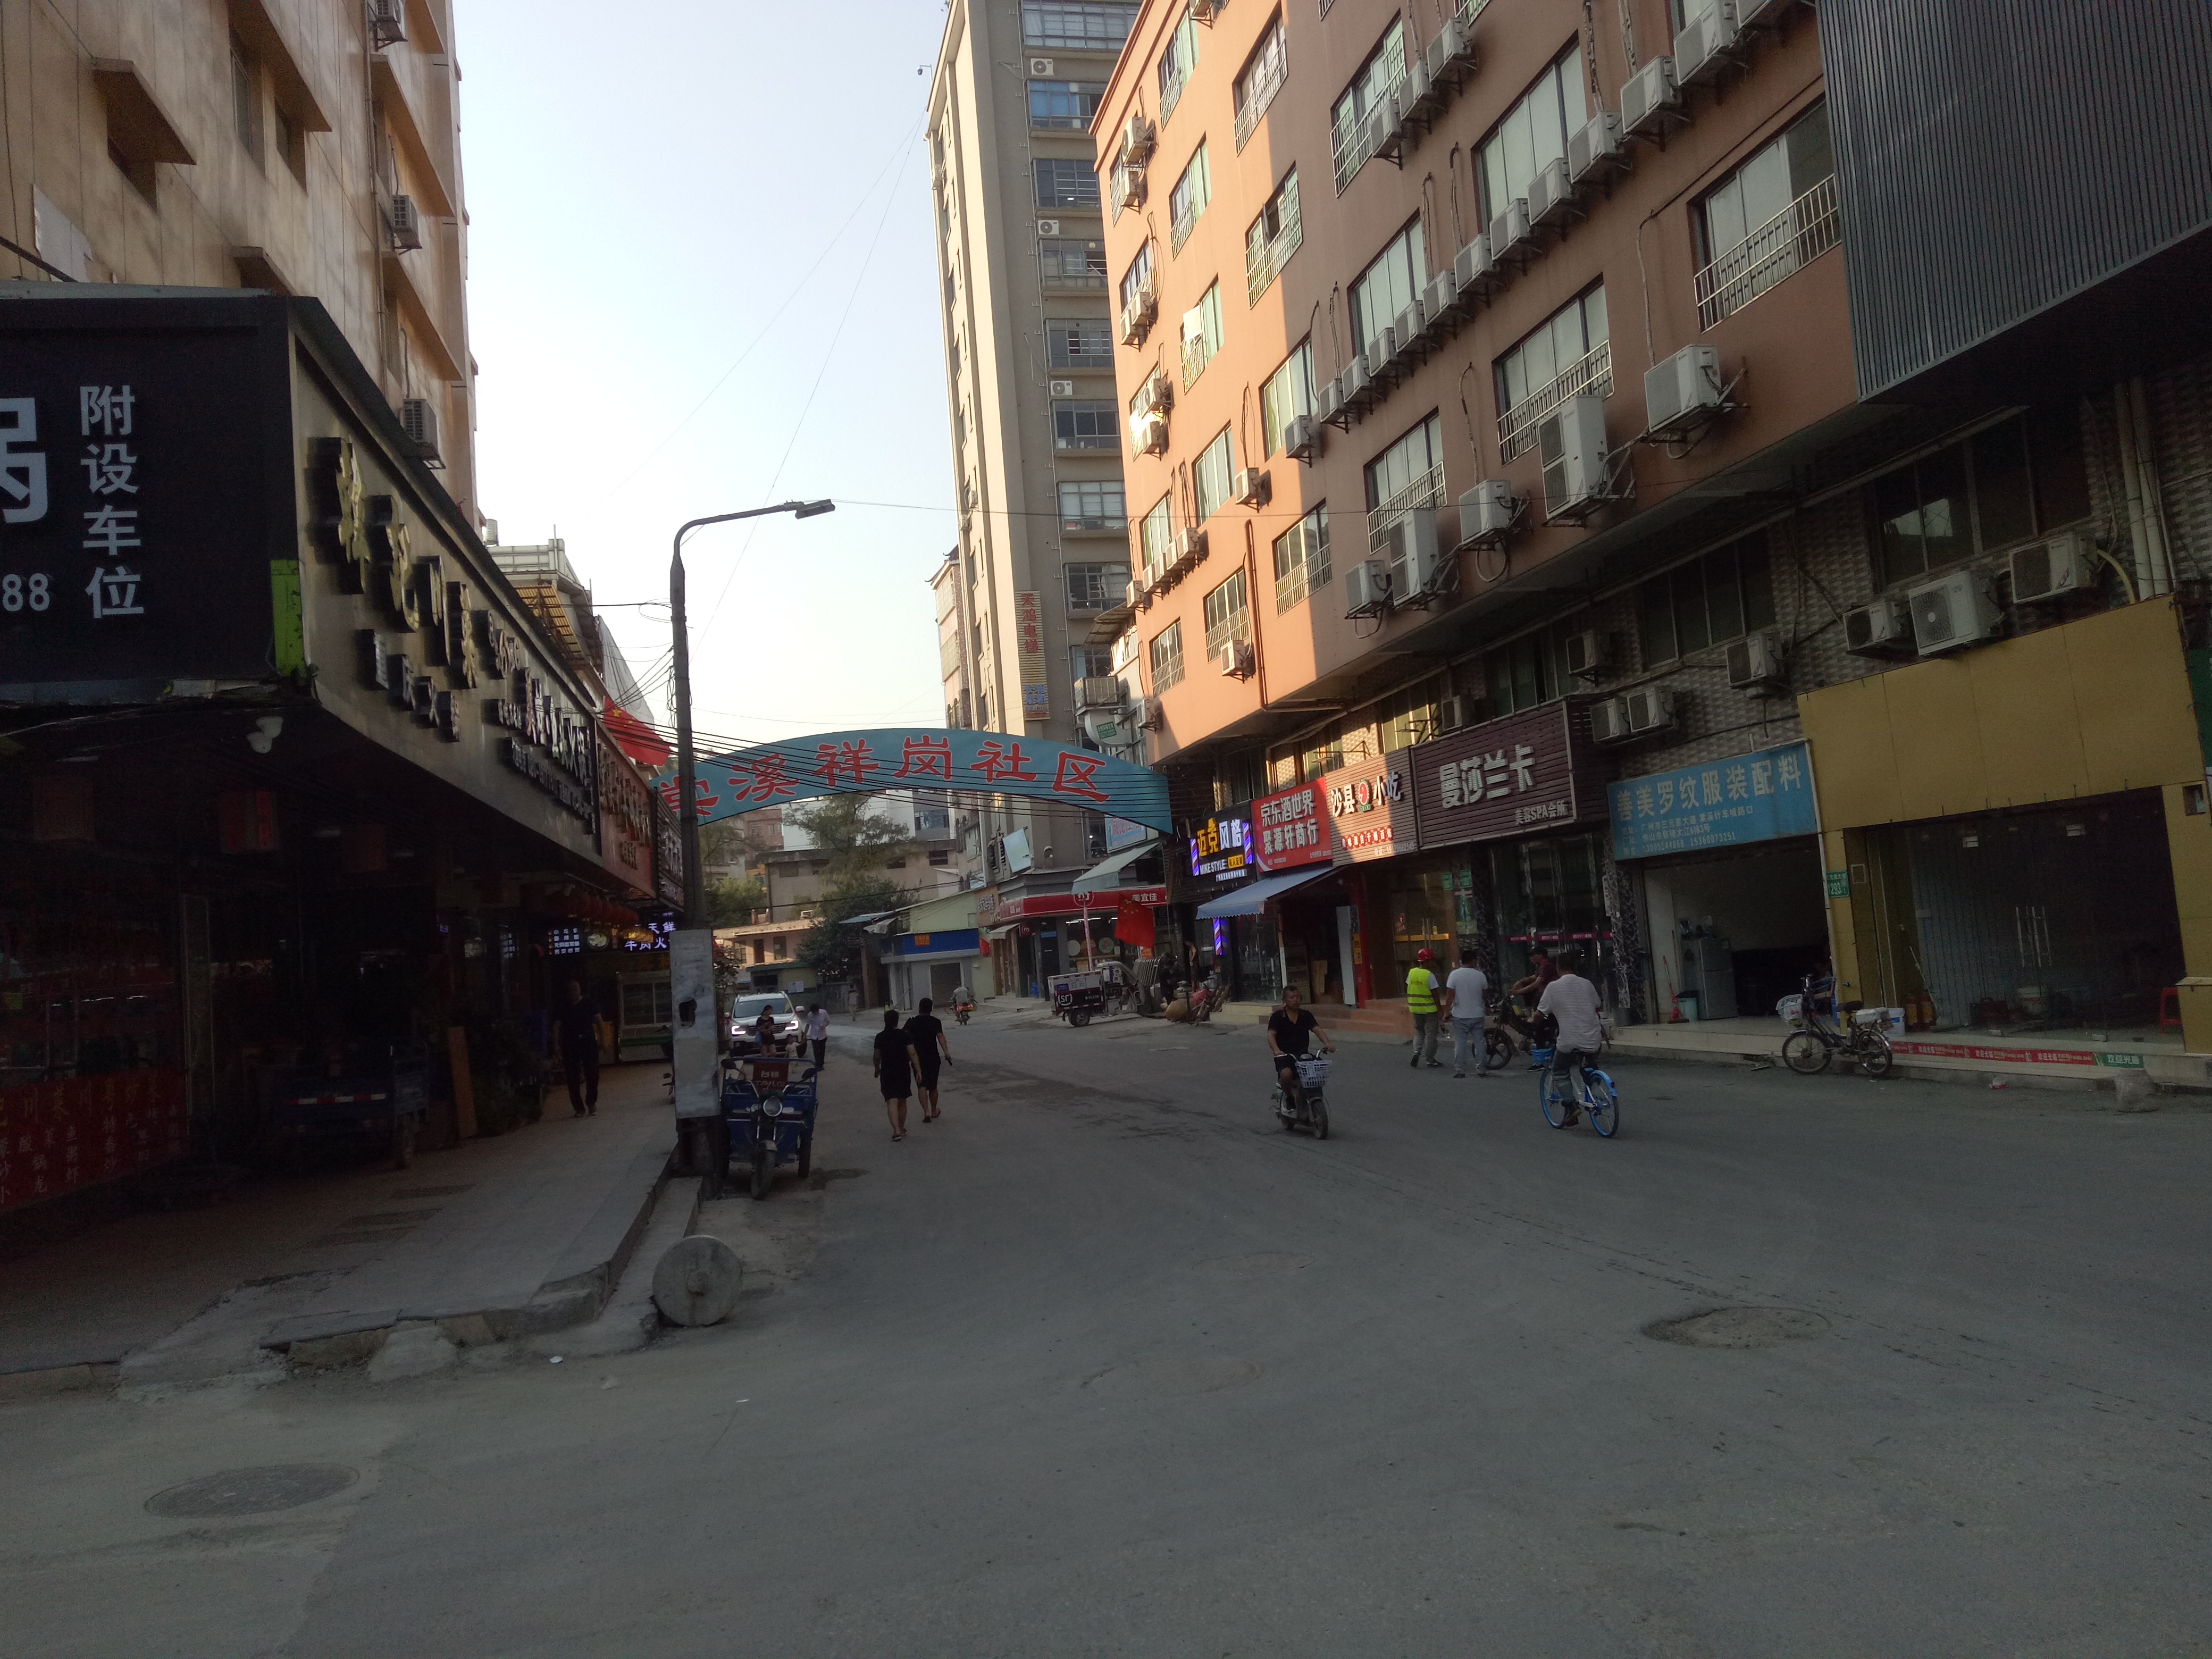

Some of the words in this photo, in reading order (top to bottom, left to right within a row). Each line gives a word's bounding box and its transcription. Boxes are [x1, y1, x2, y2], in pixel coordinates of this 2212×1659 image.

[80, 386, 145, 619] 附设车位
[1330, 784, 1356, 818] 沙县
[1373, 771, 1402, 806] 小吃
[1439, 744, 1535, 809] 曼莎兰卡
[1616, 755, 1802, 822] 善美罗纹服装配料
[1260, 789, 1316, 828] 京东酒世界
[1197, 817, 1243, 857] 迈克风格
[1262, 818, 1319, 855] 聚源轩商行
[1132, 892, 1158, 902] 美宜佳
